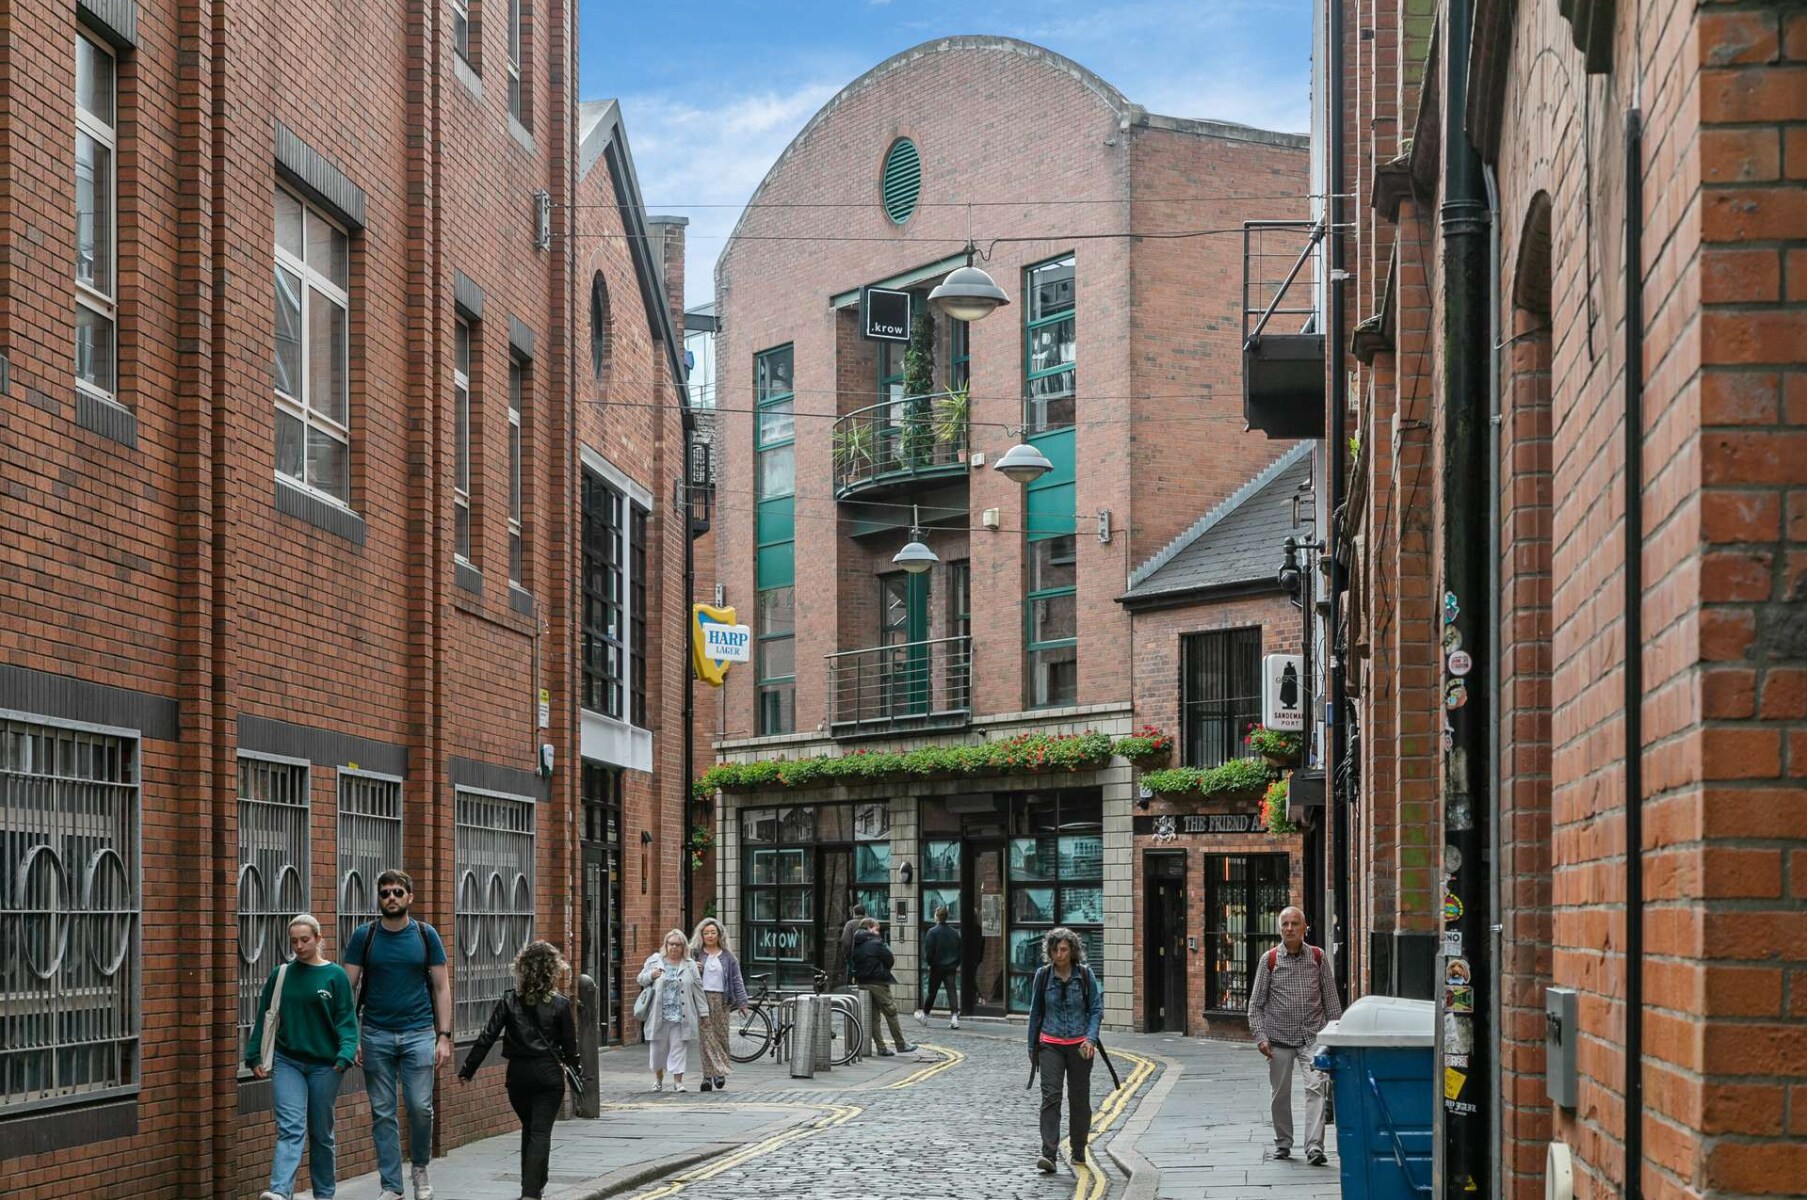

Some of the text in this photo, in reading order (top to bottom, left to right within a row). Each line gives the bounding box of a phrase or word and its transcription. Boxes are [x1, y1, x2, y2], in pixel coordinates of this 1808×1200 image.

[871, 322, 903, 334] .krow
[708, 630, 748, 646] HARP
[715, 646, 741, 655] LAGER
[1183, 815, 1207, 832] THE
[1208, 815, 1249, 832] FRIEND
[760, 927, 798, 948] .krow
